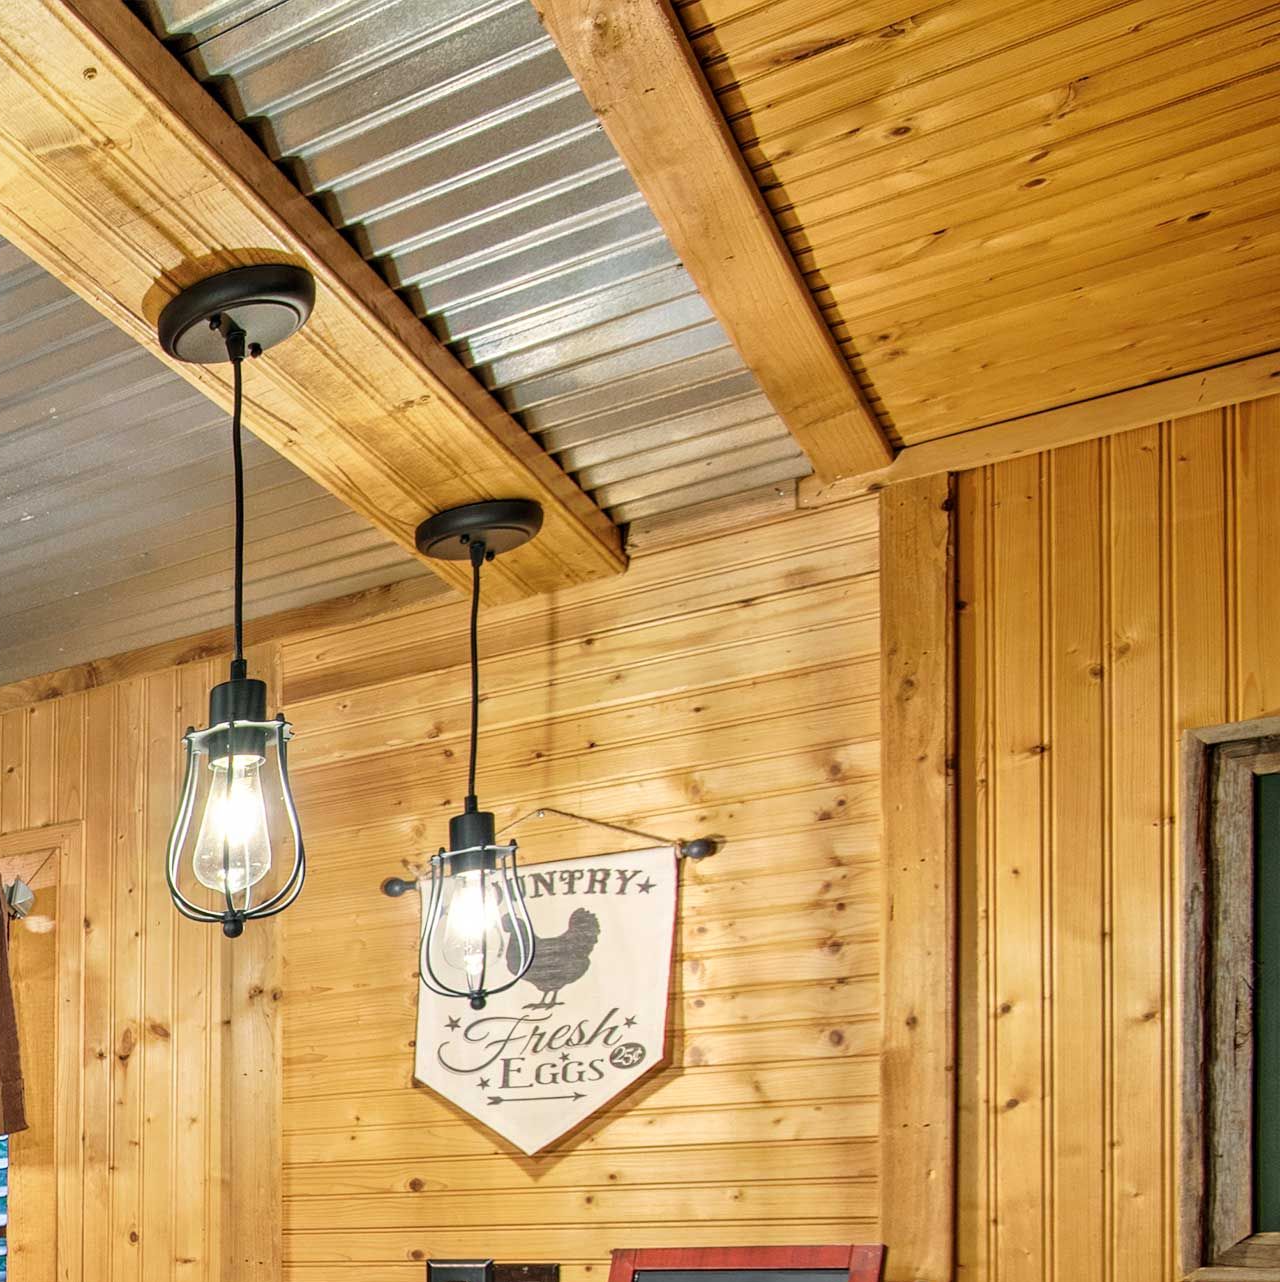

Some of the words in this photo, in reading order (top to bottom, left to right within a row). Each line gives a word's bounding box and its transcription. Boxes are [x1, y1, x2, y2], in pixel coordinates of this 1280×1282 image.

[491, 868, 644, 906] UNTRY
[437, 1007, 624, 1073] Fresh
[498, 1056, 606, 1089] EGGS
